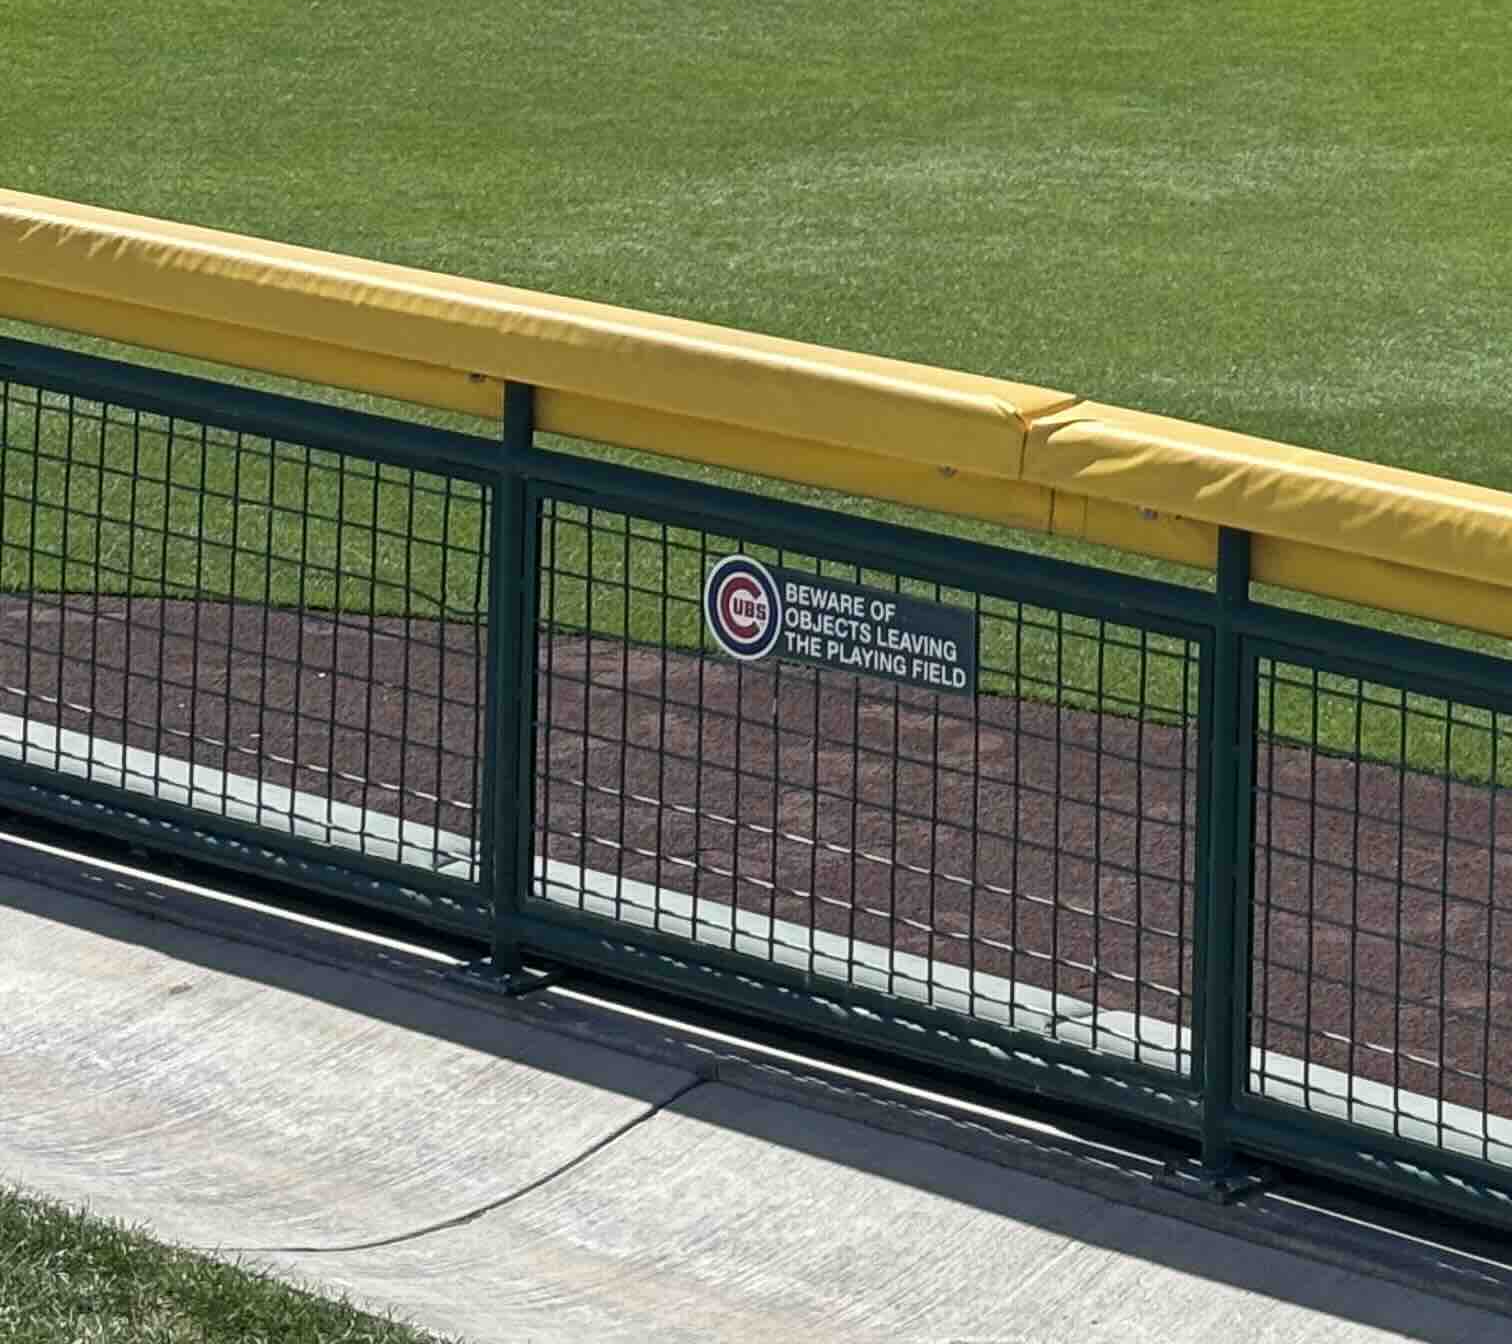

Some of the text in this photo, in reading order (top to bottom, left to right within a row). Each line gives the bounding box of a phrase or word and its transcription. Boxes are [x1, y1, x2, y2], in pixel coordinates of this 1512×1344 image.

[785, 582, 896, 623] BEWARE OF
[784, 607, 958, 662] OBJECTS LEAVING
[784, 631, 967, 689] THE PLAYING FIELD
